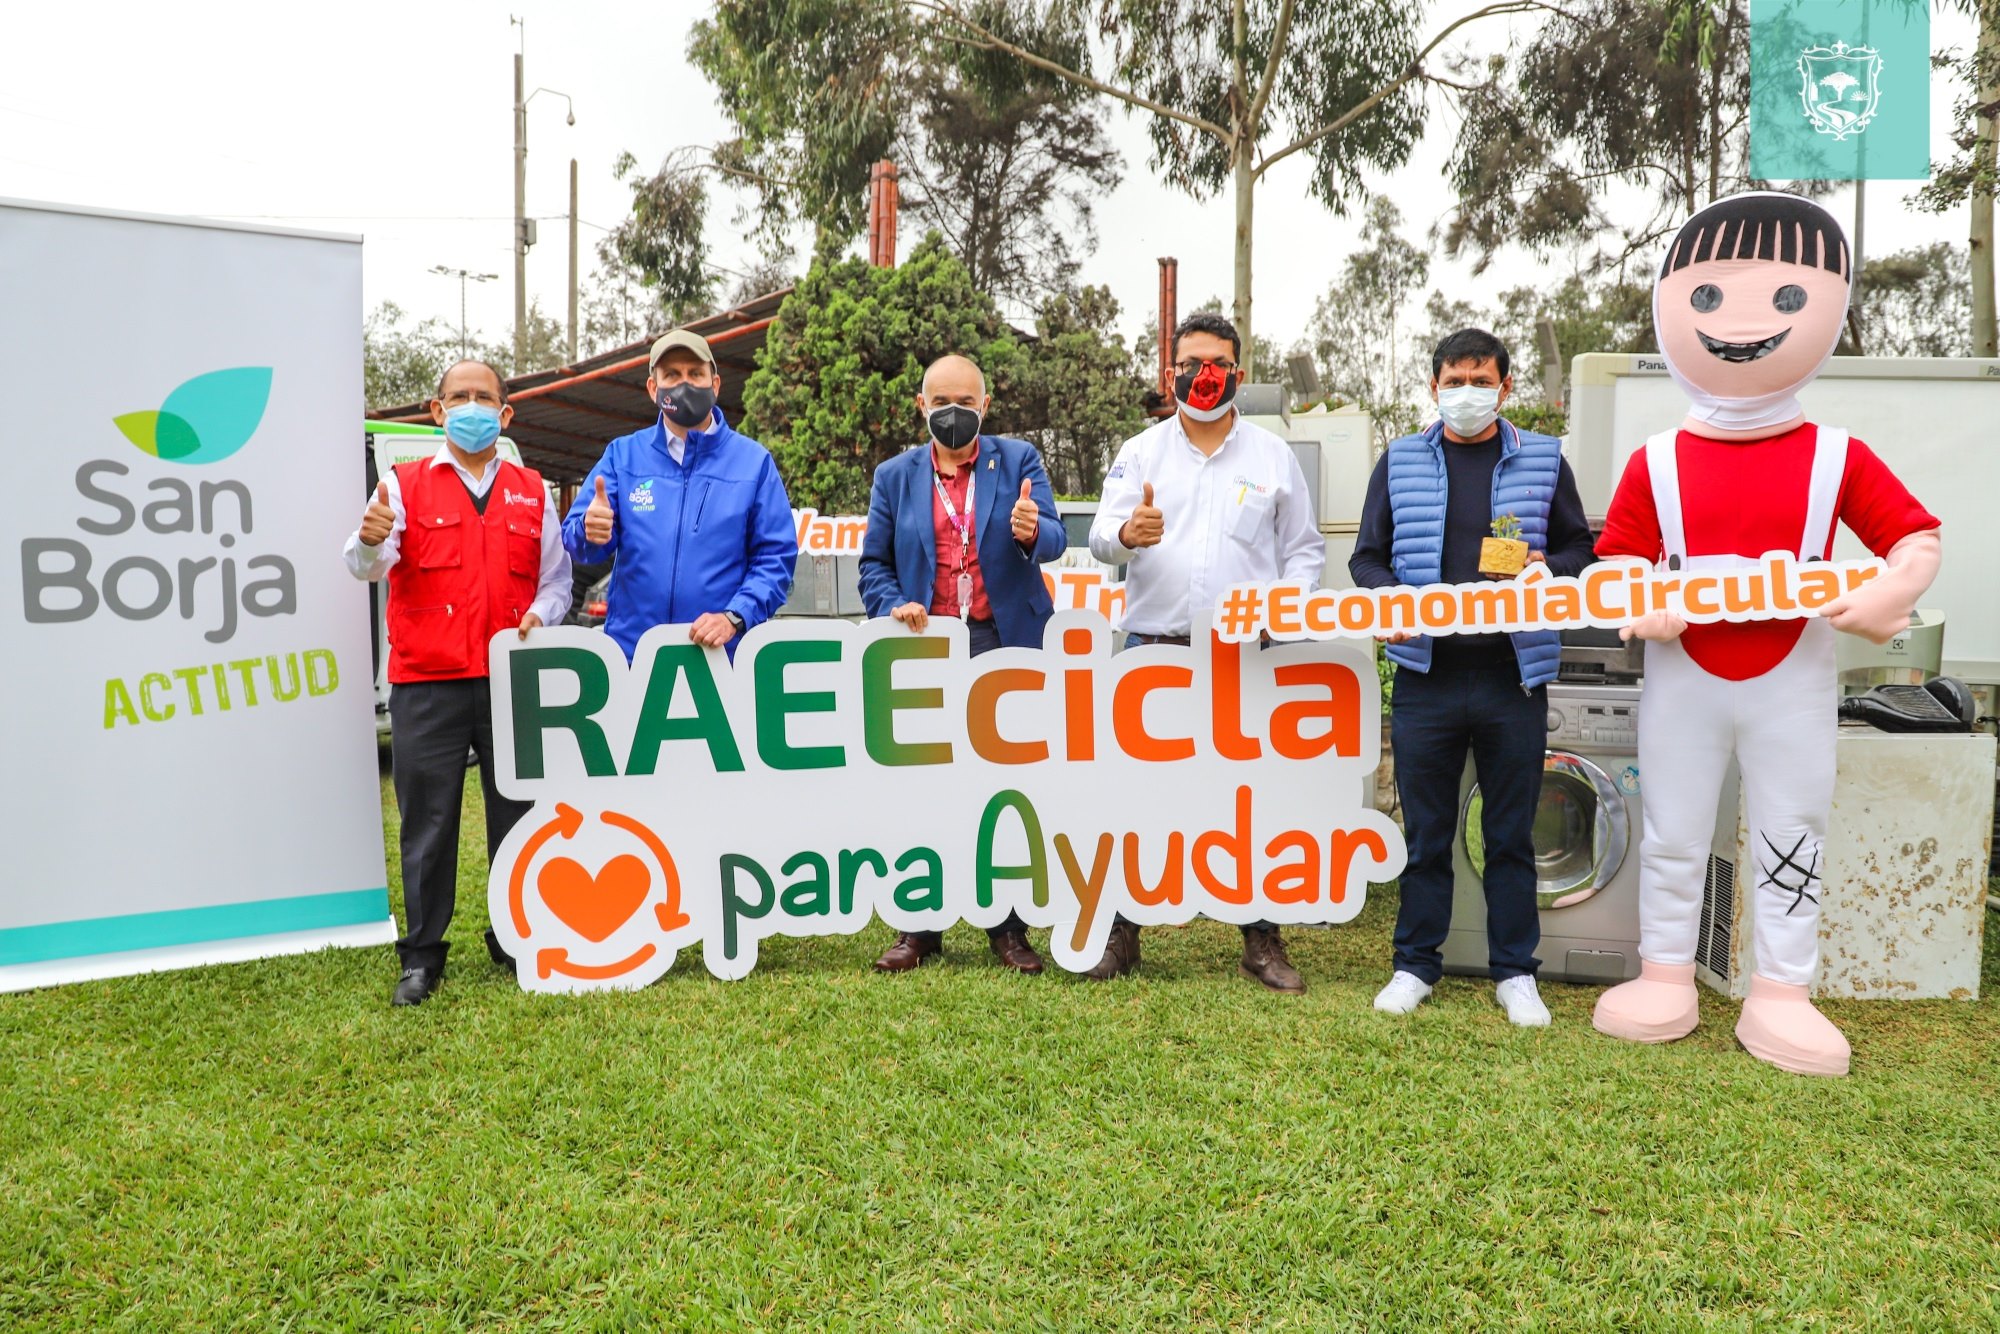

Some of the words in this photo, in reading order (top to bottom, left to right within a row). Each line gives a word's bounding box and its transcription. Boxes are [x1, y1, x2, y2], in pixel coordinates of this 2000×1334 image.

[75, 459, 253, 536] San
[635, 487, 651, 497] San
[21, 533, 297, 644] Borja
[103, 648, 339, 729] ACTITUD
[509, 627, 1361, 780] RAEEcicla
[719, 846, 943, 960] para
[975, 784, 1388, 952] Ayudar
